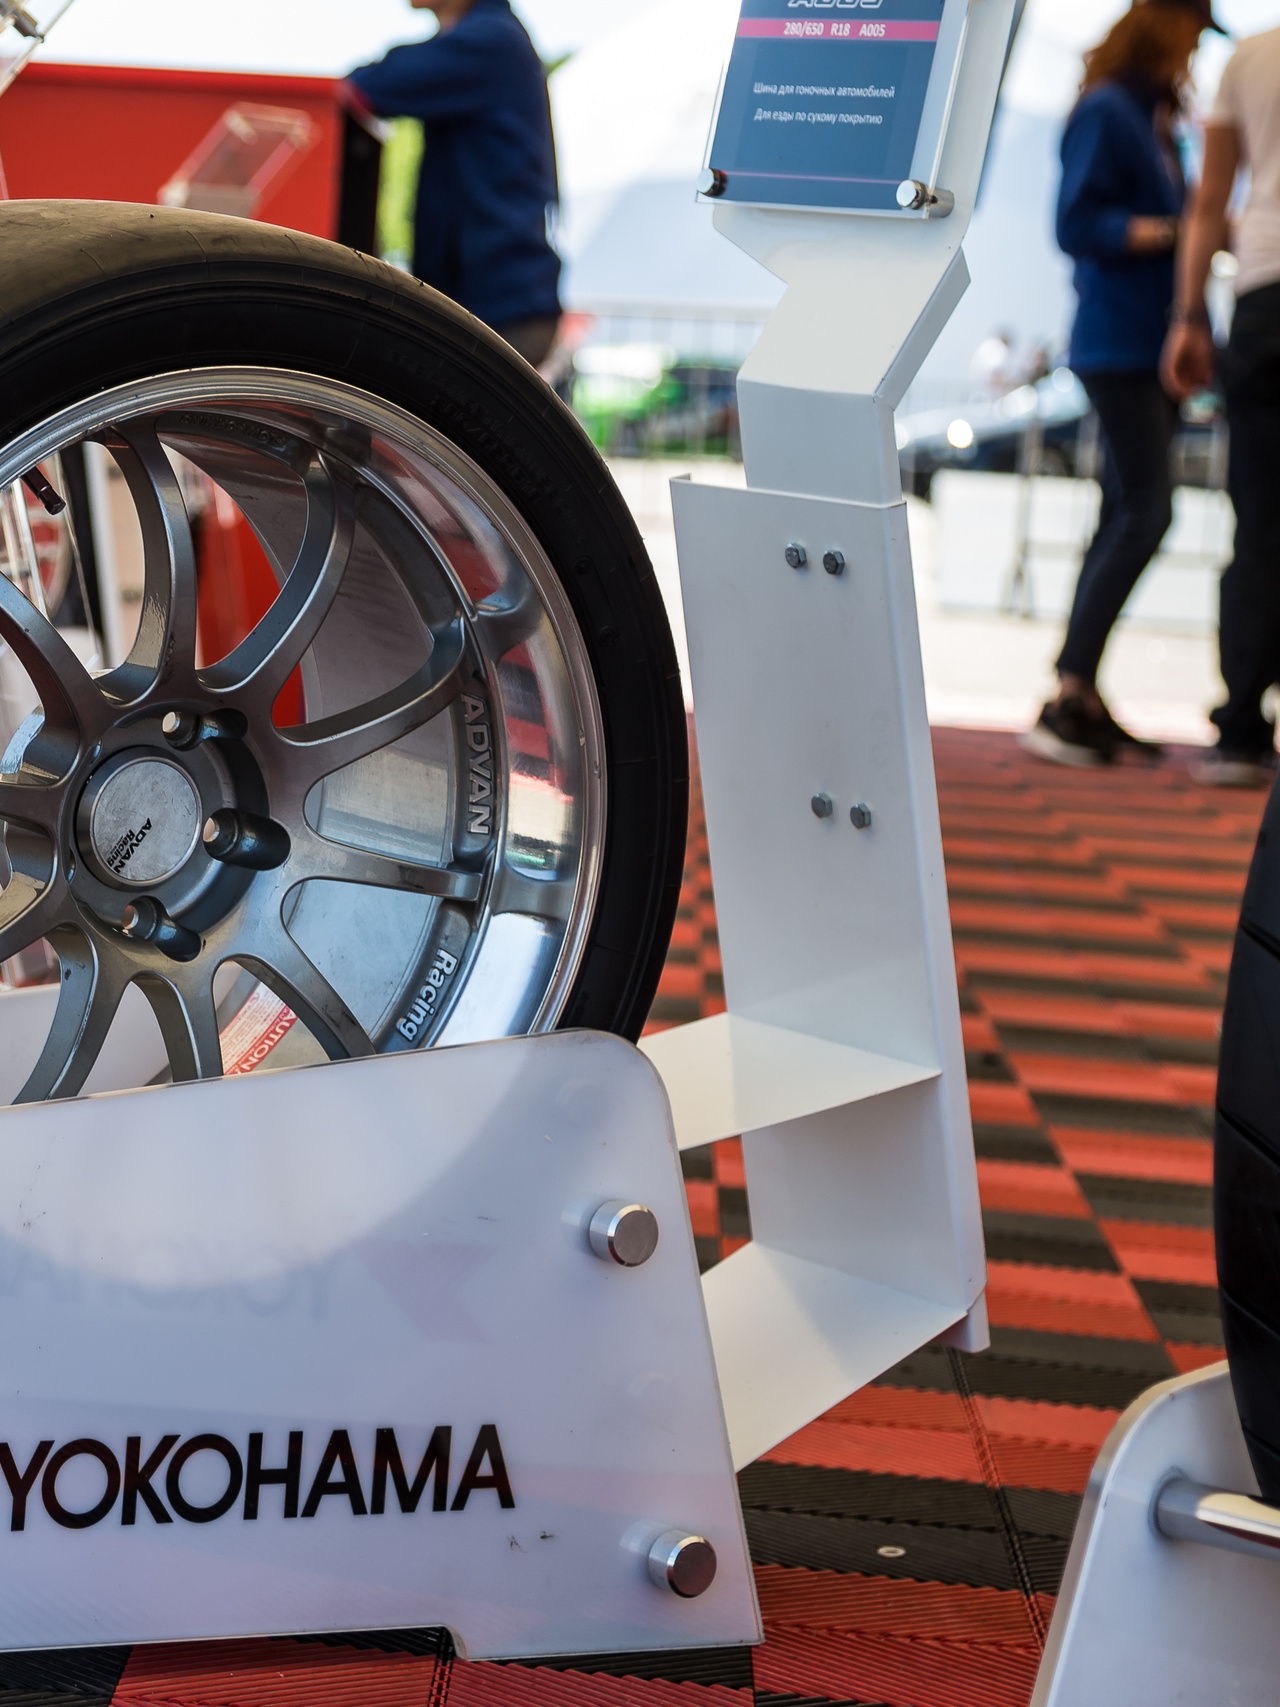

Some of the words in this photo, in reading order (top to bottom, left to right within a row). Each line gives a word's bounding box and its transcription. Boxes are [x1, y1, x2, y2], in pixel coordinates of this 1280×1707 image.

[783, 21, 825, 37] 280/650
[830, 22, 851, 36] R18
[859, 23, 886, 37] A005
[753, 82, 778, 94] Шина
[778, 84, 795, 96] для
[795, 84, 836, 97] гоночных
[836, 85, 895, 98] автомобилей
[753, 107, 772, 121] Для
[772, 110, 794, 122] езды
[795, 111, 807, 121] по
[807, 112, 838, 125] сухому
[838, 113, 883, 126] покрытию
[461, 692, 491, 837] ADVAN
[107, 829, 136, 868] Racing
[114, 818, 152, 874] ADVAN
[396, 947, 459, 1042] Racing
[239, 1008, 298, 1071] AUTION
